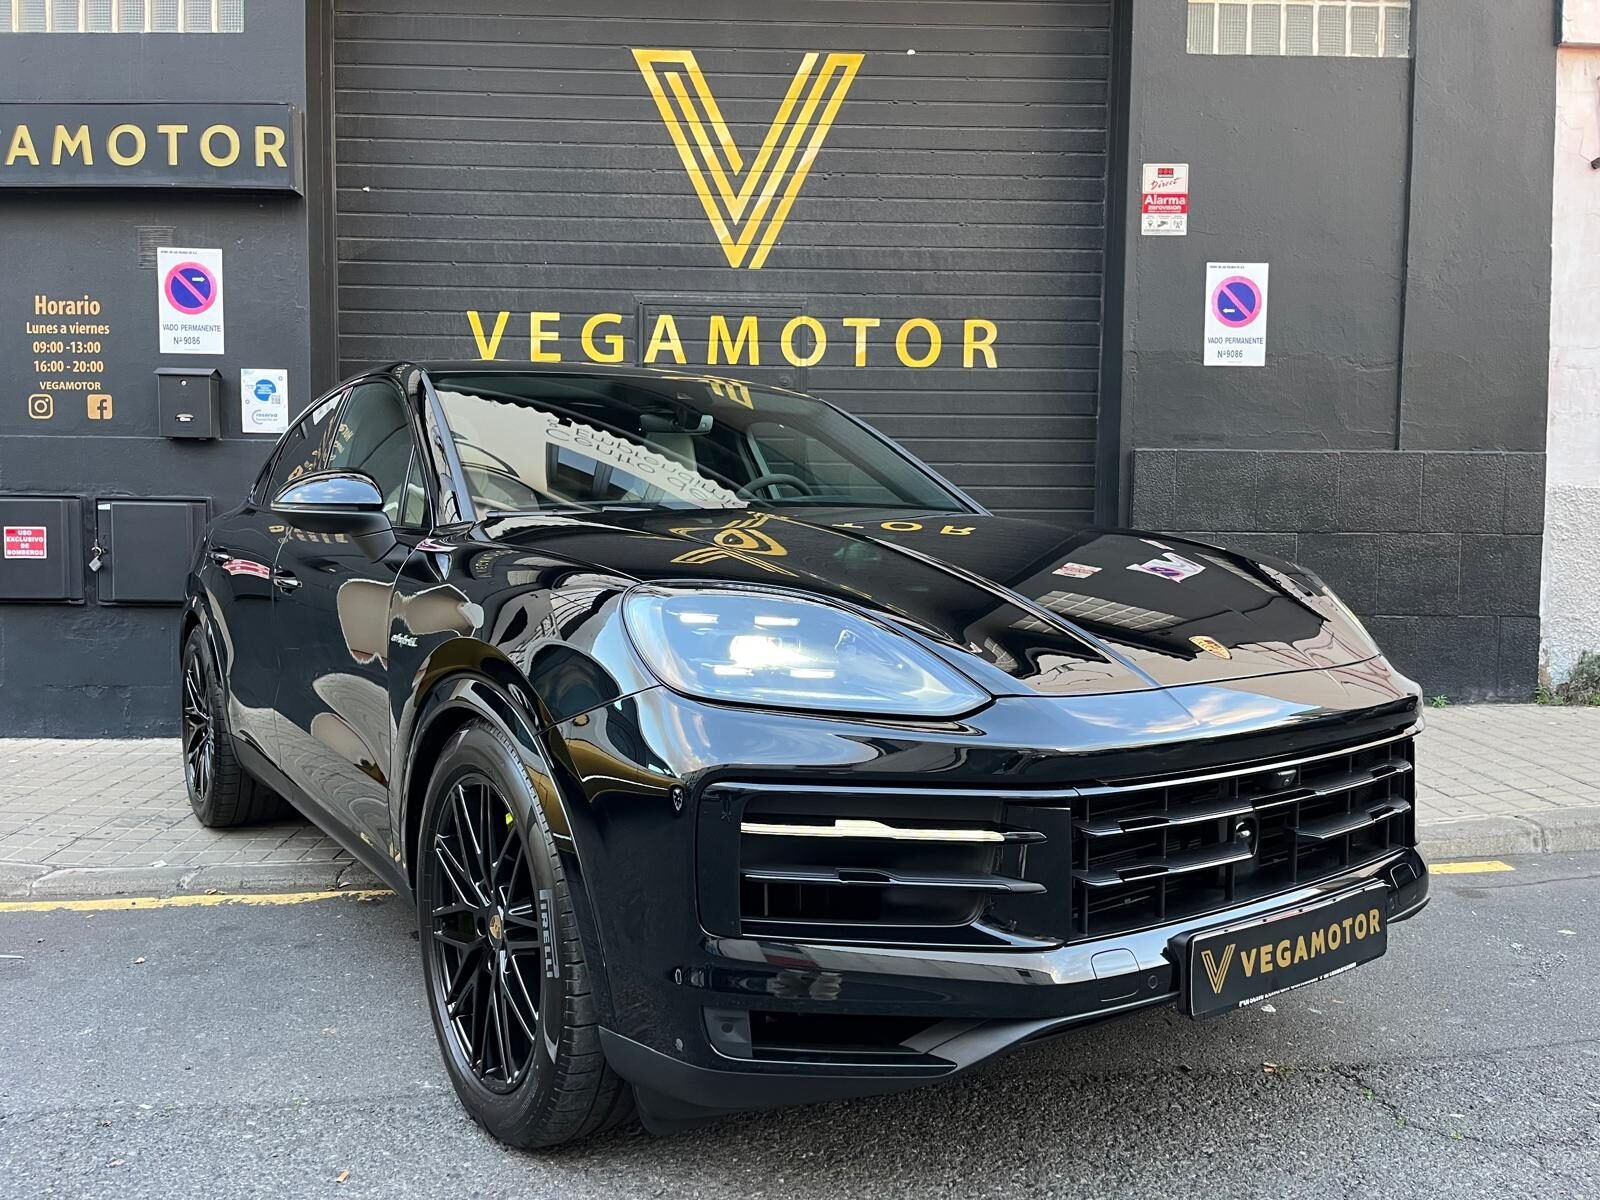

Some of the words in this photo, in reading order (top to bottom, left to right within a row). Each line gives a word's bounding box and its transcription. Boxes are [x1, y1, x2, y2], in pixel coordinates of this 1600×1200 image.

[0, 123, 288, 168] AMOTOR
[1144, 194, 1186, 205] Alarma
[34, 295, 101, 315] Horario
[26, 322, 58, 334] Lunes
[60, 325, 67, 334] a
[69, 322, 110, 335] viernes
[162, 323, 179, 331] VADO
[180, 324, 221, 332] PERMANENTE
[466, 310, 998, 369] VEGAMOTOR
[1225, 337, 1264, 345] PERMANENTE
[32, 341, 64, 353] 09:00
[33, 360, 64, 373] 16:00
[73, 360, 104, 373] 20:00
[39, 381, 102, 390] VEGAMOTOR
[539, 889, 560, 979] PIRELLI
[1240, 908, 1381, 977] VEGAMOTOR
